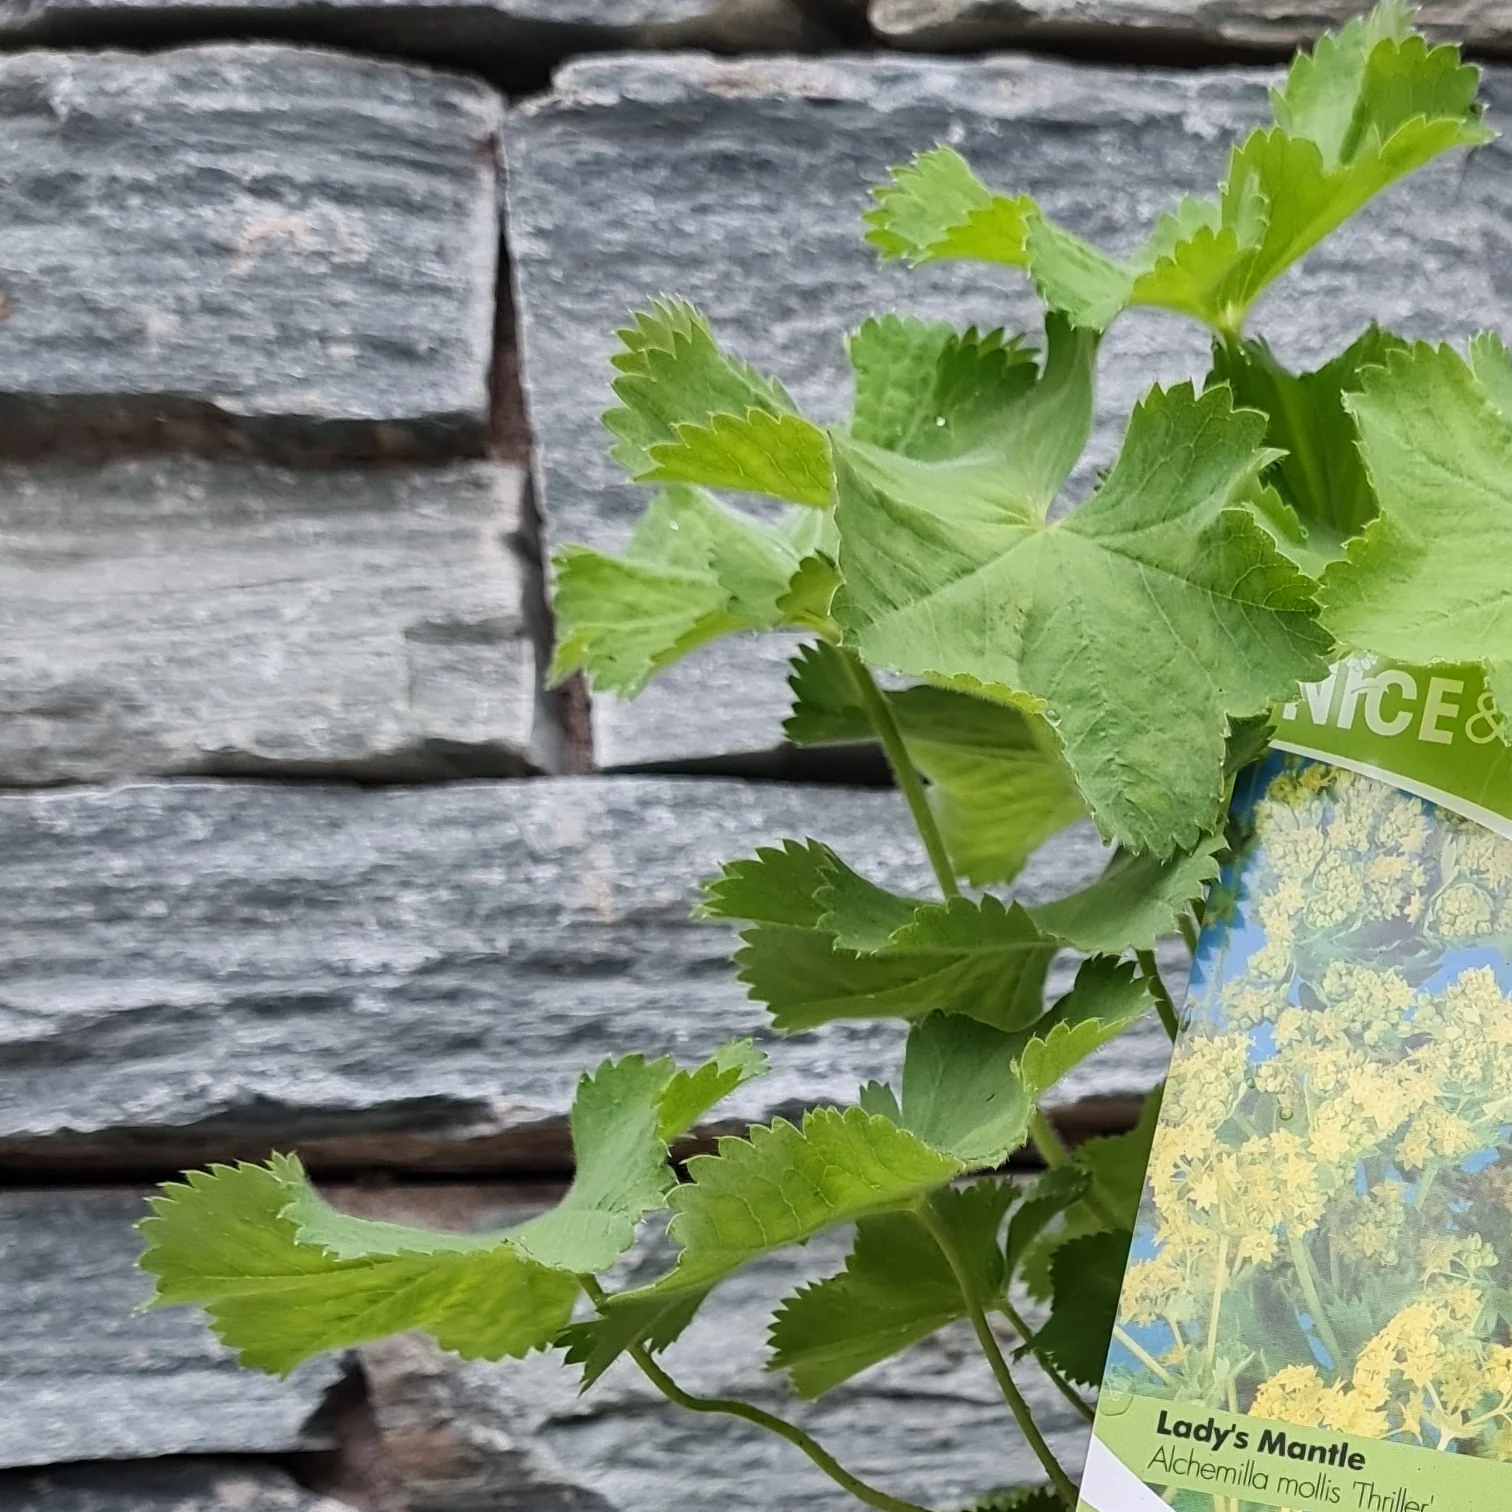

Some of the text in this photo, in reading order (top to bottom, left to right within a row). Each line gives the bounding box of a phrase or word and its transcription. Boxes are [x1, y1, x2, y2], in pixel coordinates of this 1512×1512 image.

[1156, 1410, 1366, 1471] Lady's Mantle
[1147, 1445, 1269, 1491] Alchemilla
[1276, 1472, 1341, 1504] mollis
